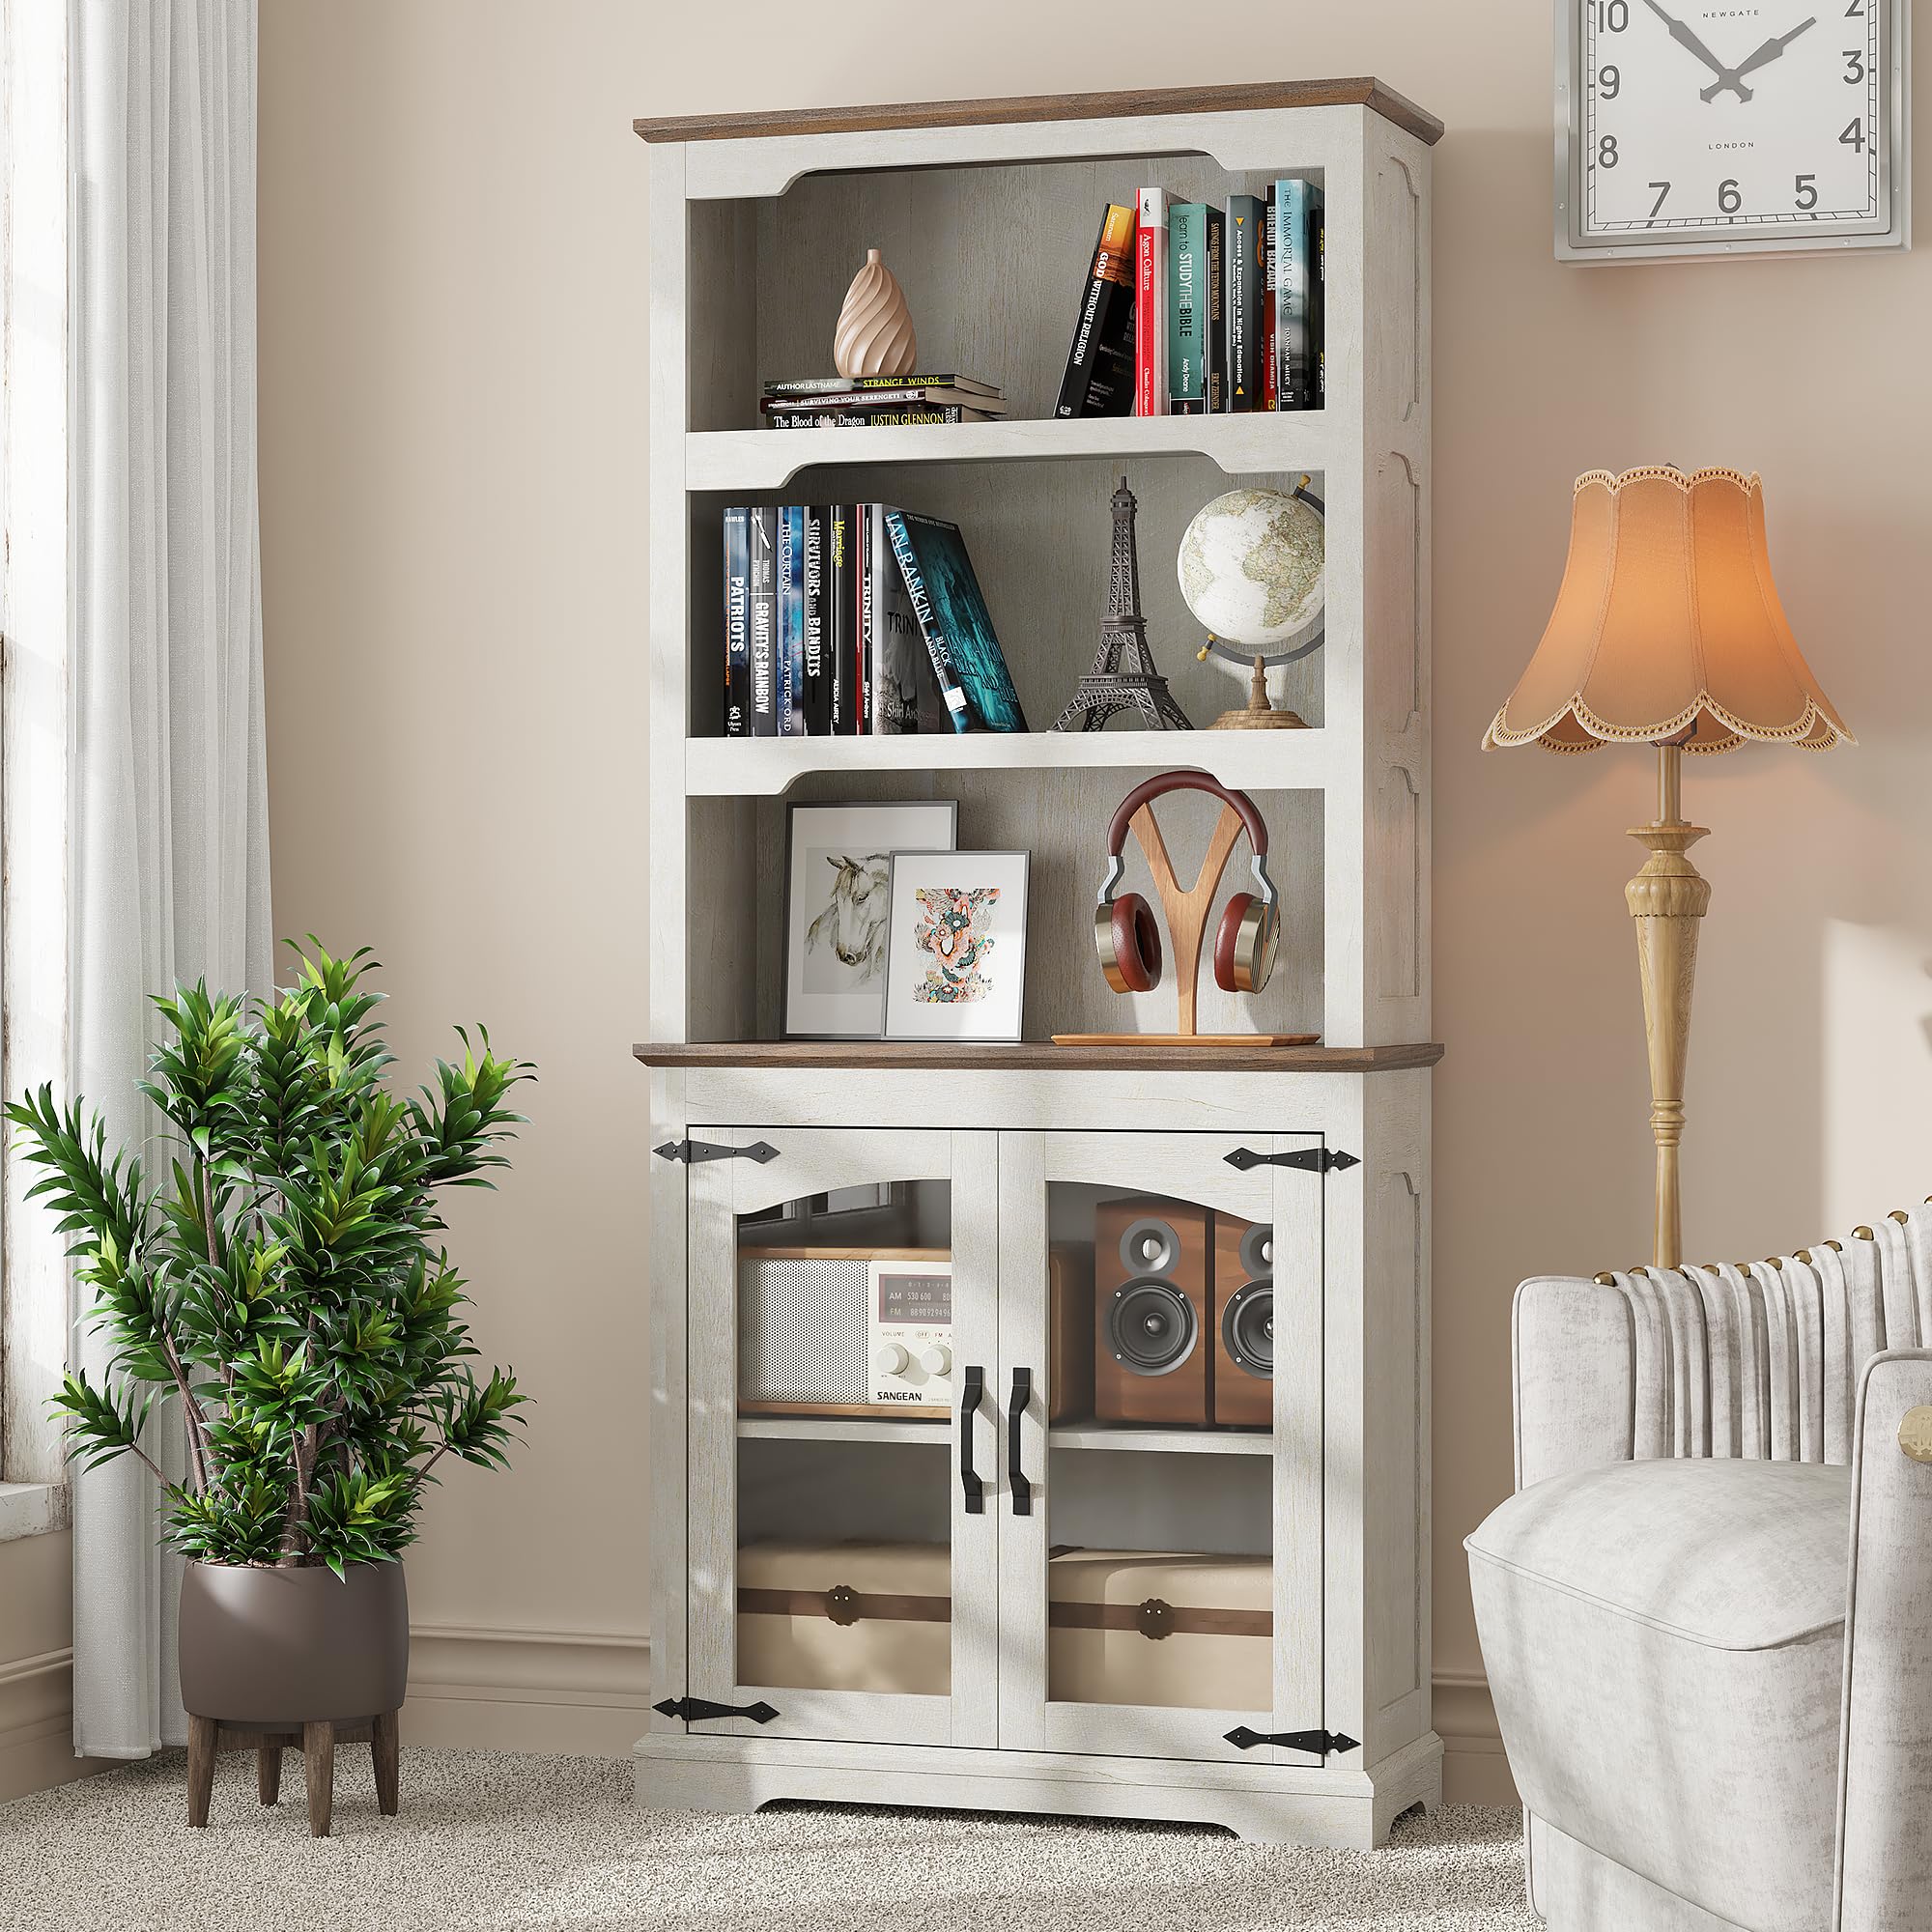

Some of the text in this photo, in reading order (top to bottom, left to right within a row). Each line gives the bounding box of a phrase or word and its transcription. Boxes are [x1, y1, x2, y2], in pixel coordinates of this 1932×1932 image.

[1599, 0, 1629, 33] 10
[1702, 9, 1759, 19] NEWGATE
[1598, 65, 1620, 99] 9
[1841, 49, 1864, 85] 3
[1599, 135, 1619, 169] 8
[1708, 141, 1755, 150] LONDON
[1838, 117, 1865, 154] 4
[1648, 181, 1671, 217] 7
[1718, 179, 1742, 213] 6
[1794, 174, 1818, 211] 5
[1179, 214, 1190, 239] learn
[1142, 233, 1151, 257] Agon
[1179, 239, 1189, 251] to
[1265, 205, 1276, 292] BHENDI BAZAAR
[1282, 188, 1293, 316] THE IMMORTAL GAME
[1143, 258, 1152, 291] Culture
[1211, 222, 1220, 321] SAYINGS FROM THE TETON MOUNTAINS
[1235, 267, 1243, 306] Expansion
[1073, 252, 1109, 366] GOD WITHOUT RELIGION
[1235, 317, 1243, 343] Higher
[863, 376, 940, 387] STRANGE WINDS
[1179, 357, 1190, 374] Andy
[800, 398, 838, 407] SURVIVING
[840, 395, 860, 404] YOUR
[1210, 372, 1220, 411] ERIC ZEHNDER
[773, 413, 866, 428] The Blood of the Dragon
[870, 413, 899, 427] JUSTIN
[900, 412, 944, 426] GLENNON
[832, 520, 845, 568] Marriage
[884, 513, 910, 550] IAN
[762, 559, 771, 583] THOMAS
[781, 522, 793, 595] THE CURTAIN
[808, 518, 821, 677] SURVIVORS AND BANDITS
[896, 551, 934, 625] RANKIN
[730, 576, 745, 652] PATRIOTS
[863, 572, 872, 644] TRINITY
[754, 601, 770, 714] GRAVITY'S RAINBOW
[923, 635, 944, 679] AND BLUE
[934, 635, 952, 667] BLACK
[783, 660, 792, 731] PATRICK ORD
[889, 1292, 902, 1300] AM
[907, 1292, 919, 1300] 530
[920, 1292, 932, 1301] 600
[890, 1307, 902, 1317] FM
[876, 1391, 923, 1402] SANGEAN
